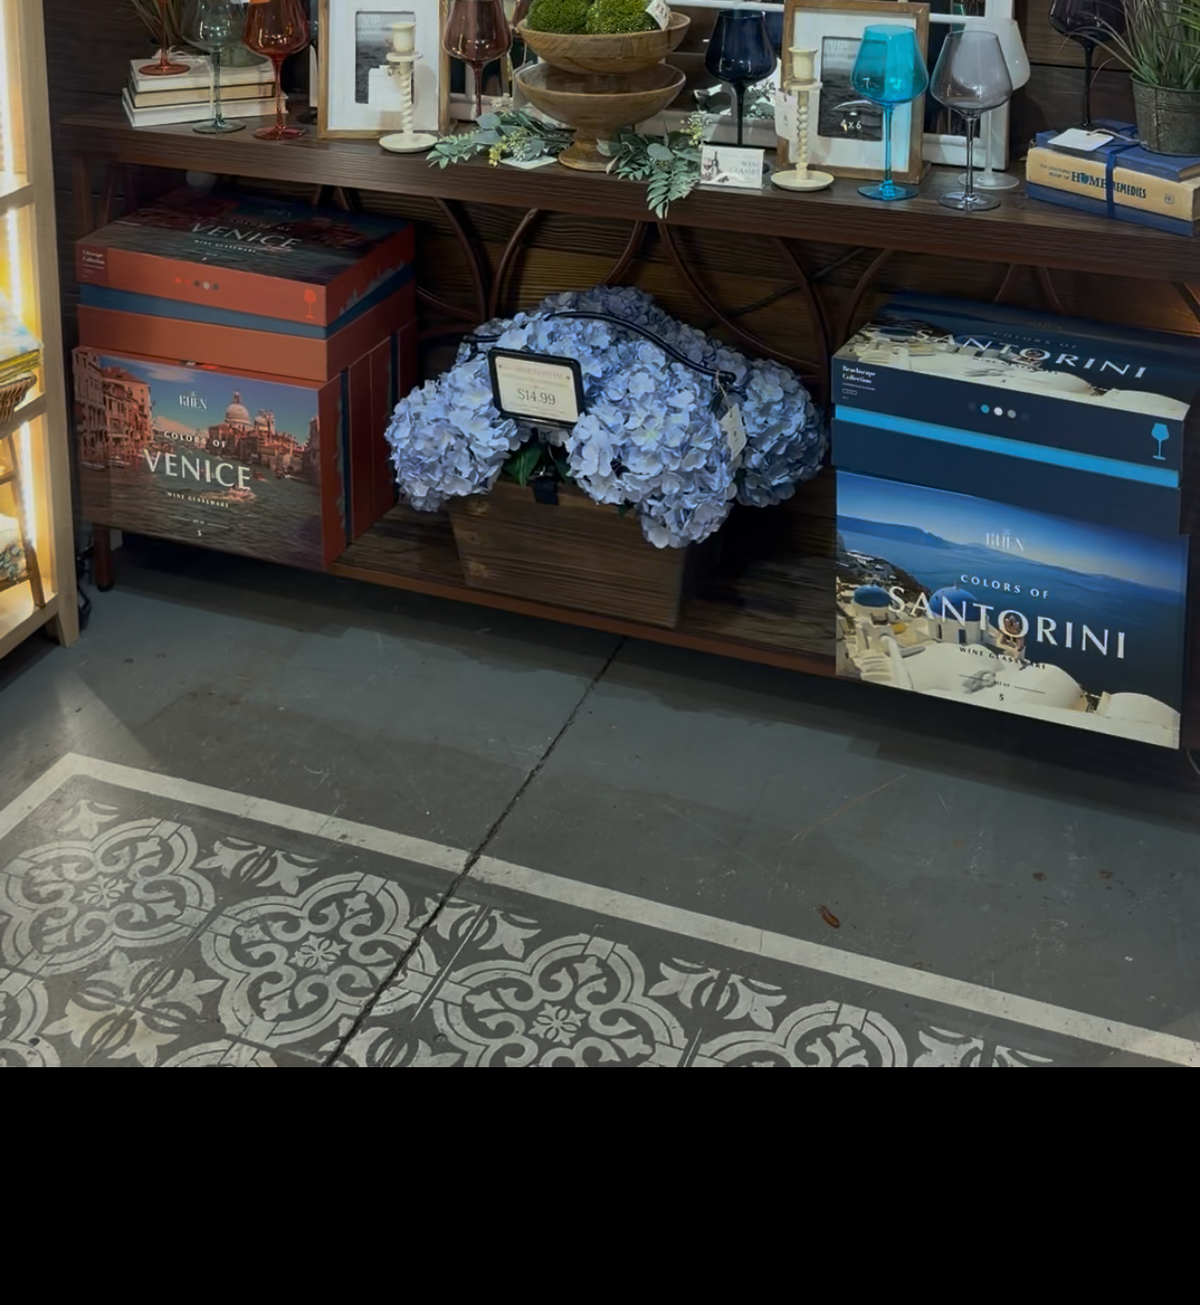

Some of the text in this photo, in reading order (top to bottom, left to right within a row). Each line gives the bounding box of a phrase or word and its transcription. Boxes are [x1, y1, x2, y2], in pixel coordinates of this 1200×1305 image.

[189, 221, 303, 250] VENICE
[915, 329, 1148, 379] SANTORINI
[517, 388, 556, 406] $14.99
[163, 430, 227, 449] COLORS OF
[143, 448, 251, 492] VENICE
[960, 574, 1049, 599] COLORS OF
[887, 585, 1126, 659] SANTORINI
[959, 646, 983, 657] WINE
[999, 693, 1005, 701] 5
